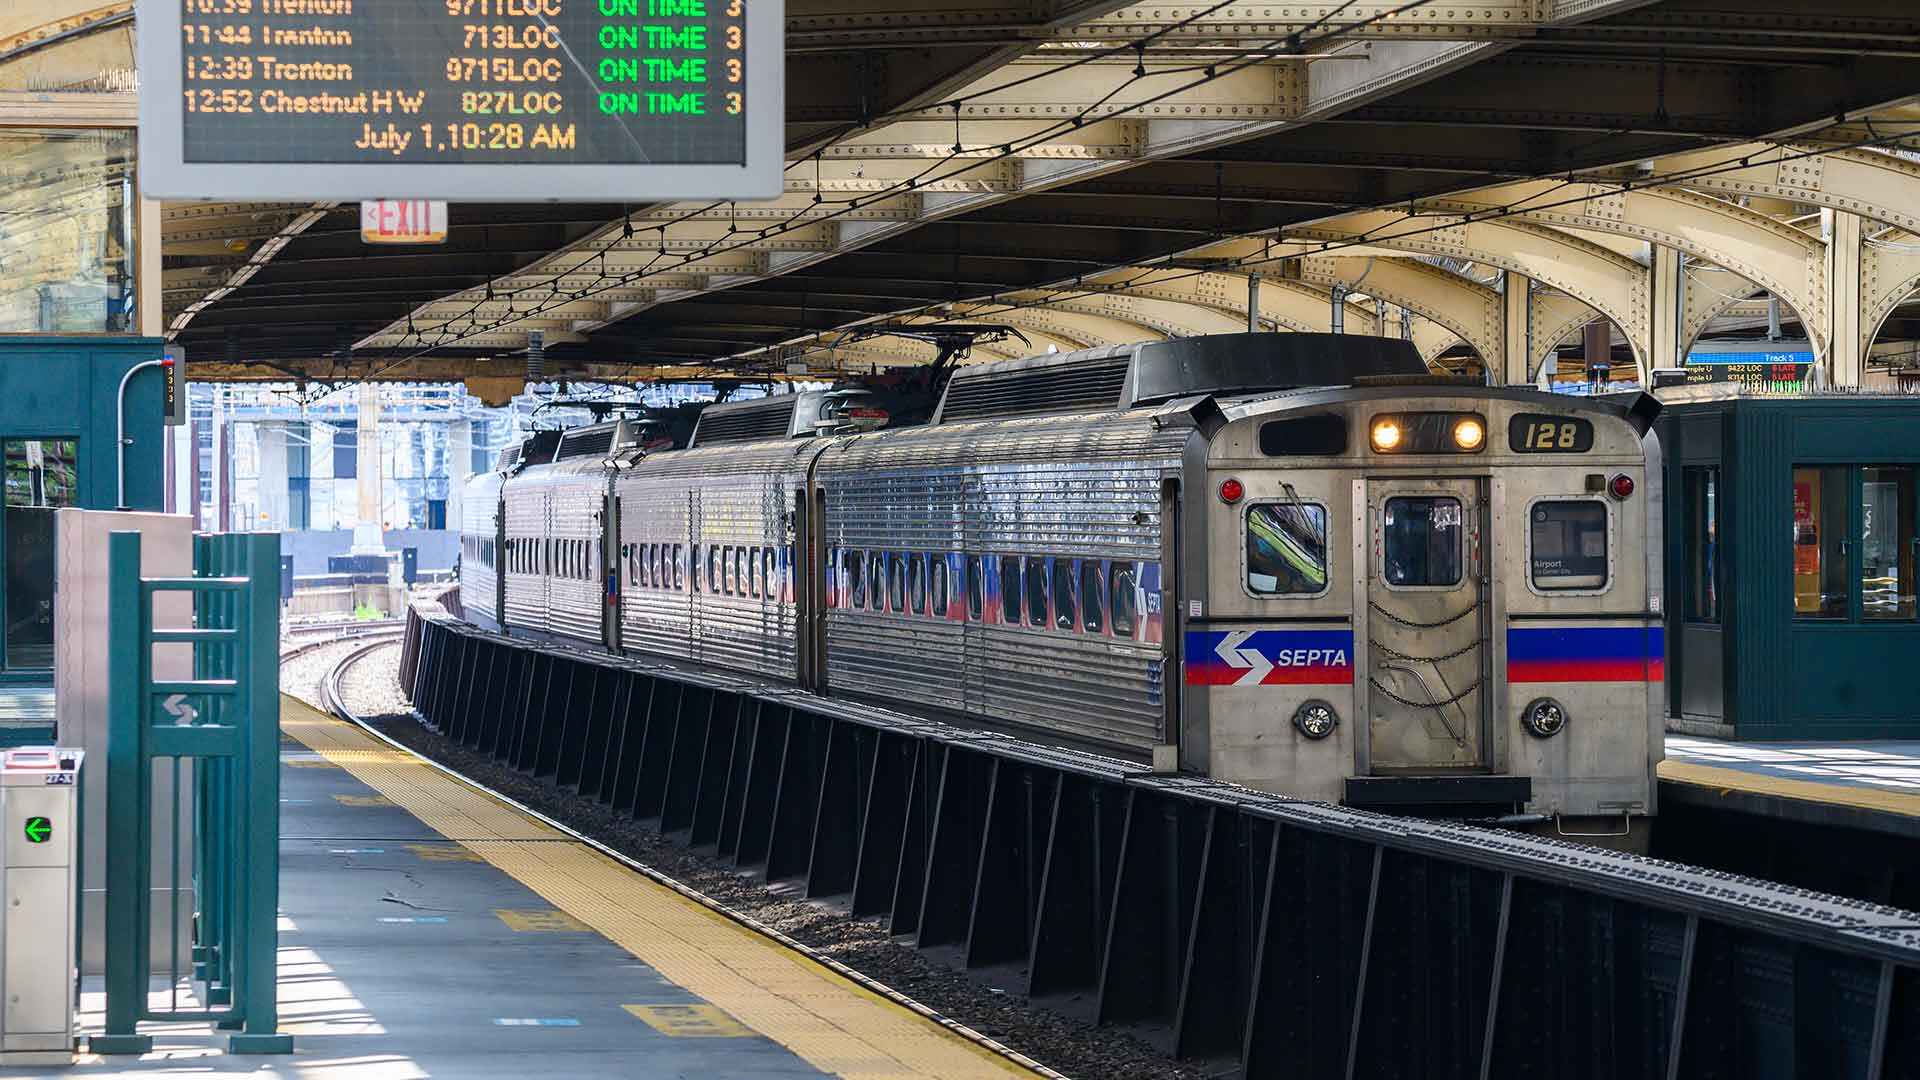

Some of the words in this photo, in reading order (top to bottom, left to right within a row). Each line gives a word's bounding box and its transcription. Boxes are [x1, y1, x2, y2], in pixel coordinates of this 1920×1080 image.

[598, 0, 639, 17] ON
[646, 0, 708, 17] TIME
[725, 0, 742, 17] 3
[263, 24, 353, 46] Trenton
[463, 25, 562, 49] 713LOC
[598, 25, 639, 50] ON
[642, 25, 708, 50] TIME
[725, 25, 742, 50] 3
[257, 55, 353, 81] Trenton
[446, 57, 563, 82] 9715LOC
[598, 58, 639, 82] ON
[642, 58, 708, 82] TIME
[725, 58, 742, 83] 3
[184, 88, 253, 113] 12:52
[259, 88, 369, 113] Chestnut
[461, 91, 563, 115] 827LOC
[598, 91, 639, 116] ON
[643, 91, 708, 116] TIME
[725, 92, 742, 115] 3
[355, 122, 413, 155] July
[529, 122, 577, 150] AM
[376, 199, 432, 236] EXIT
[1746, 364, 1762, 372] LOC
[1778, 364, 1796, 372] LATE
[1746, 373, 1762, 381] LOC
[1778, 373, 1796, 381] LATE
[1525, 423, 1577, 448] 128
[1534, 560, 1562, 569] Airport
[1278, 649, 1347, 666] SEPTA
